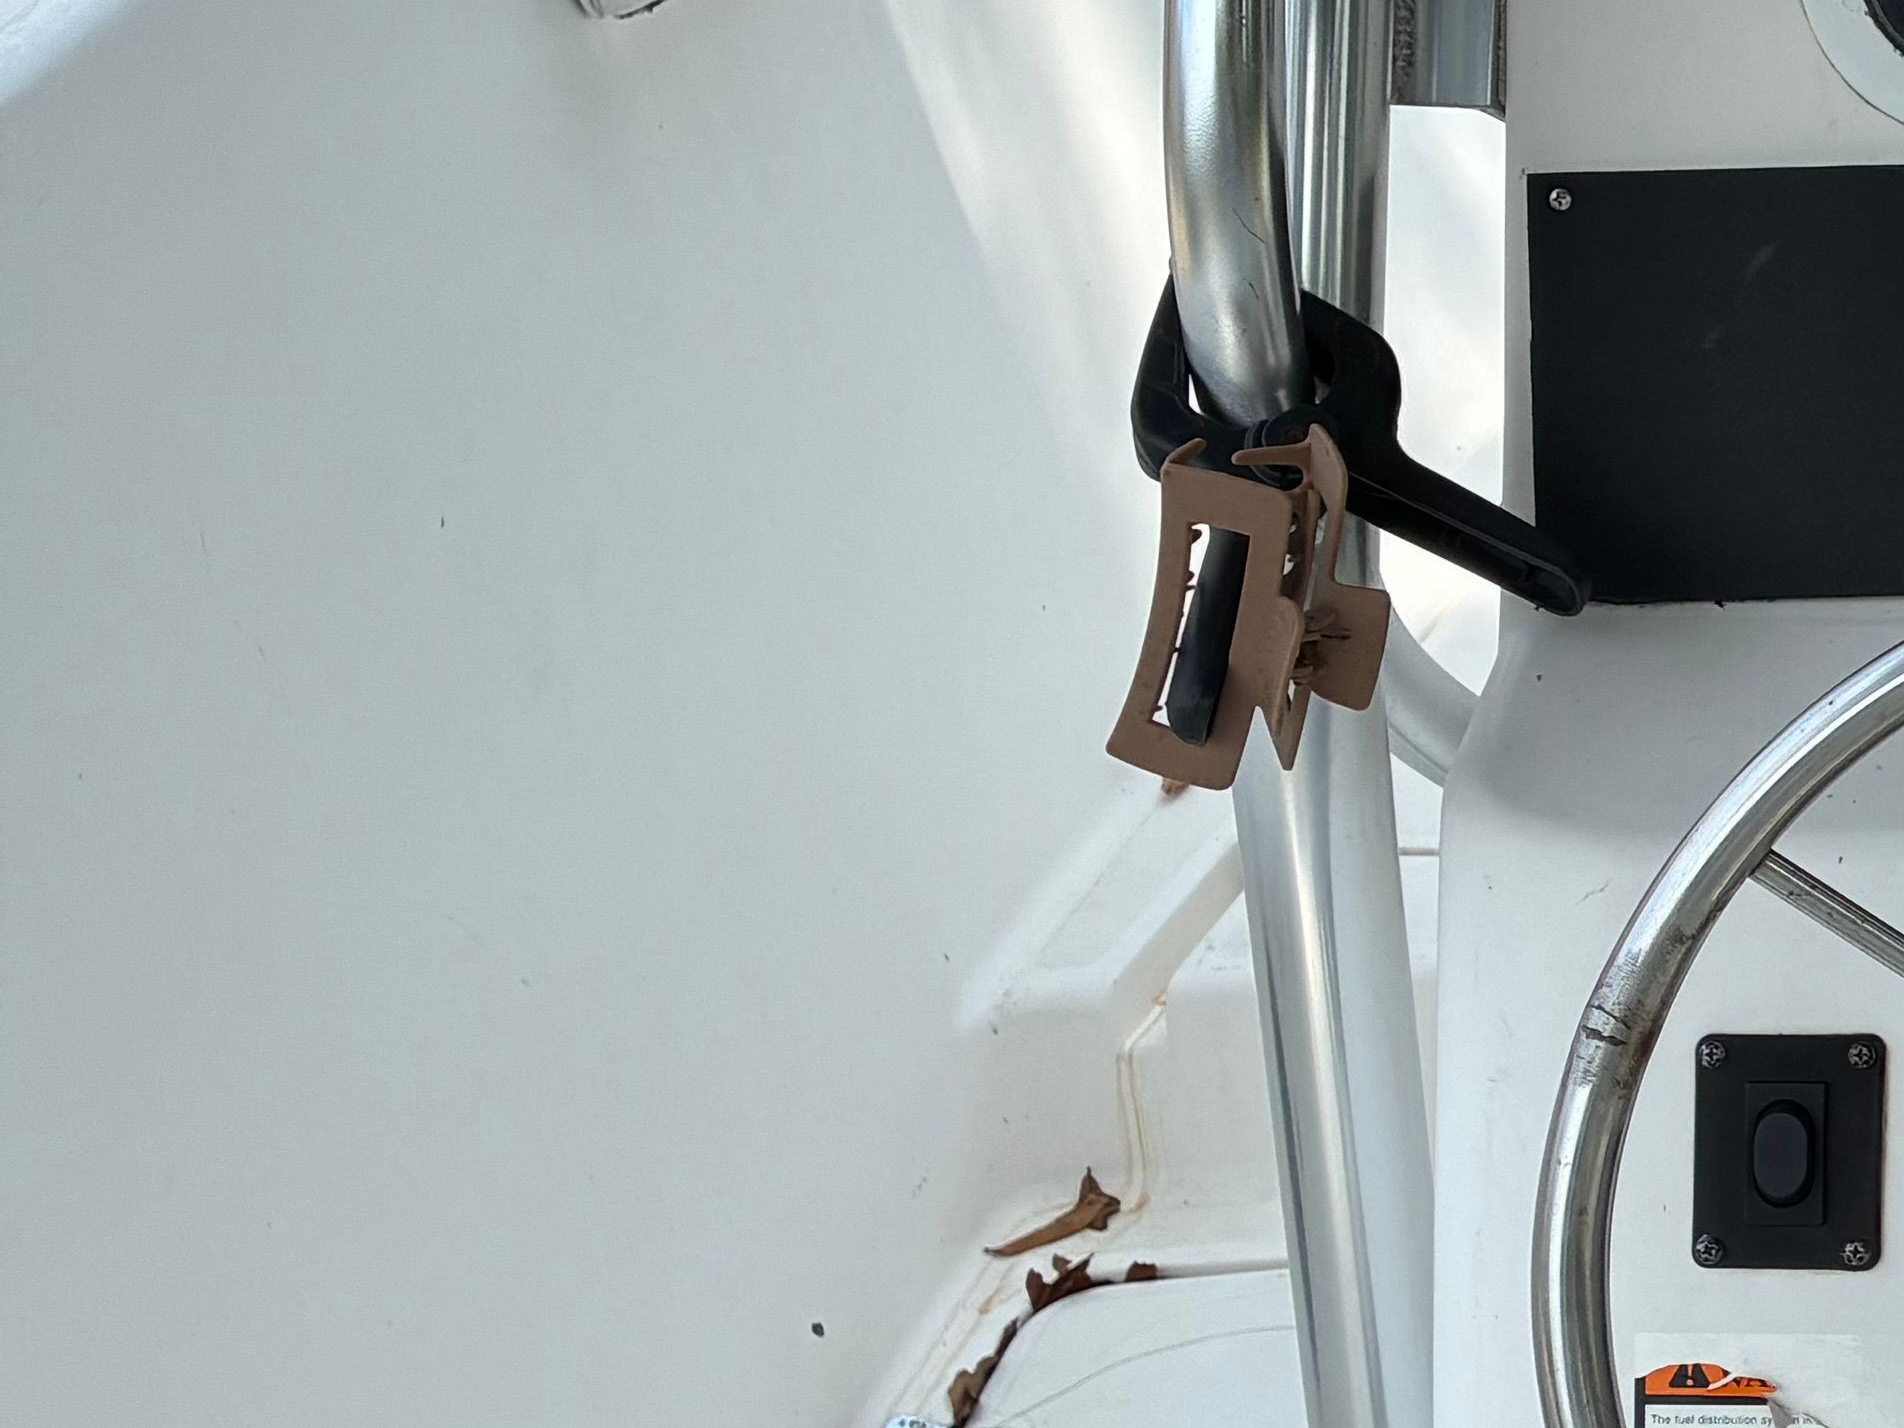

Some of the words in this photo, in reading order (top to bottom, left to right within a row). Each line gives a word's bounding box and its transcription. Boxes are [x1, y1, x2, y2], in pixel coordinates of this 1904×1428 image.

[1651, 1414, 1671, 1425] The
[1674, 1414, 1695, 1425] fuel
[1697, 1414, 1757, 1425] distribution
